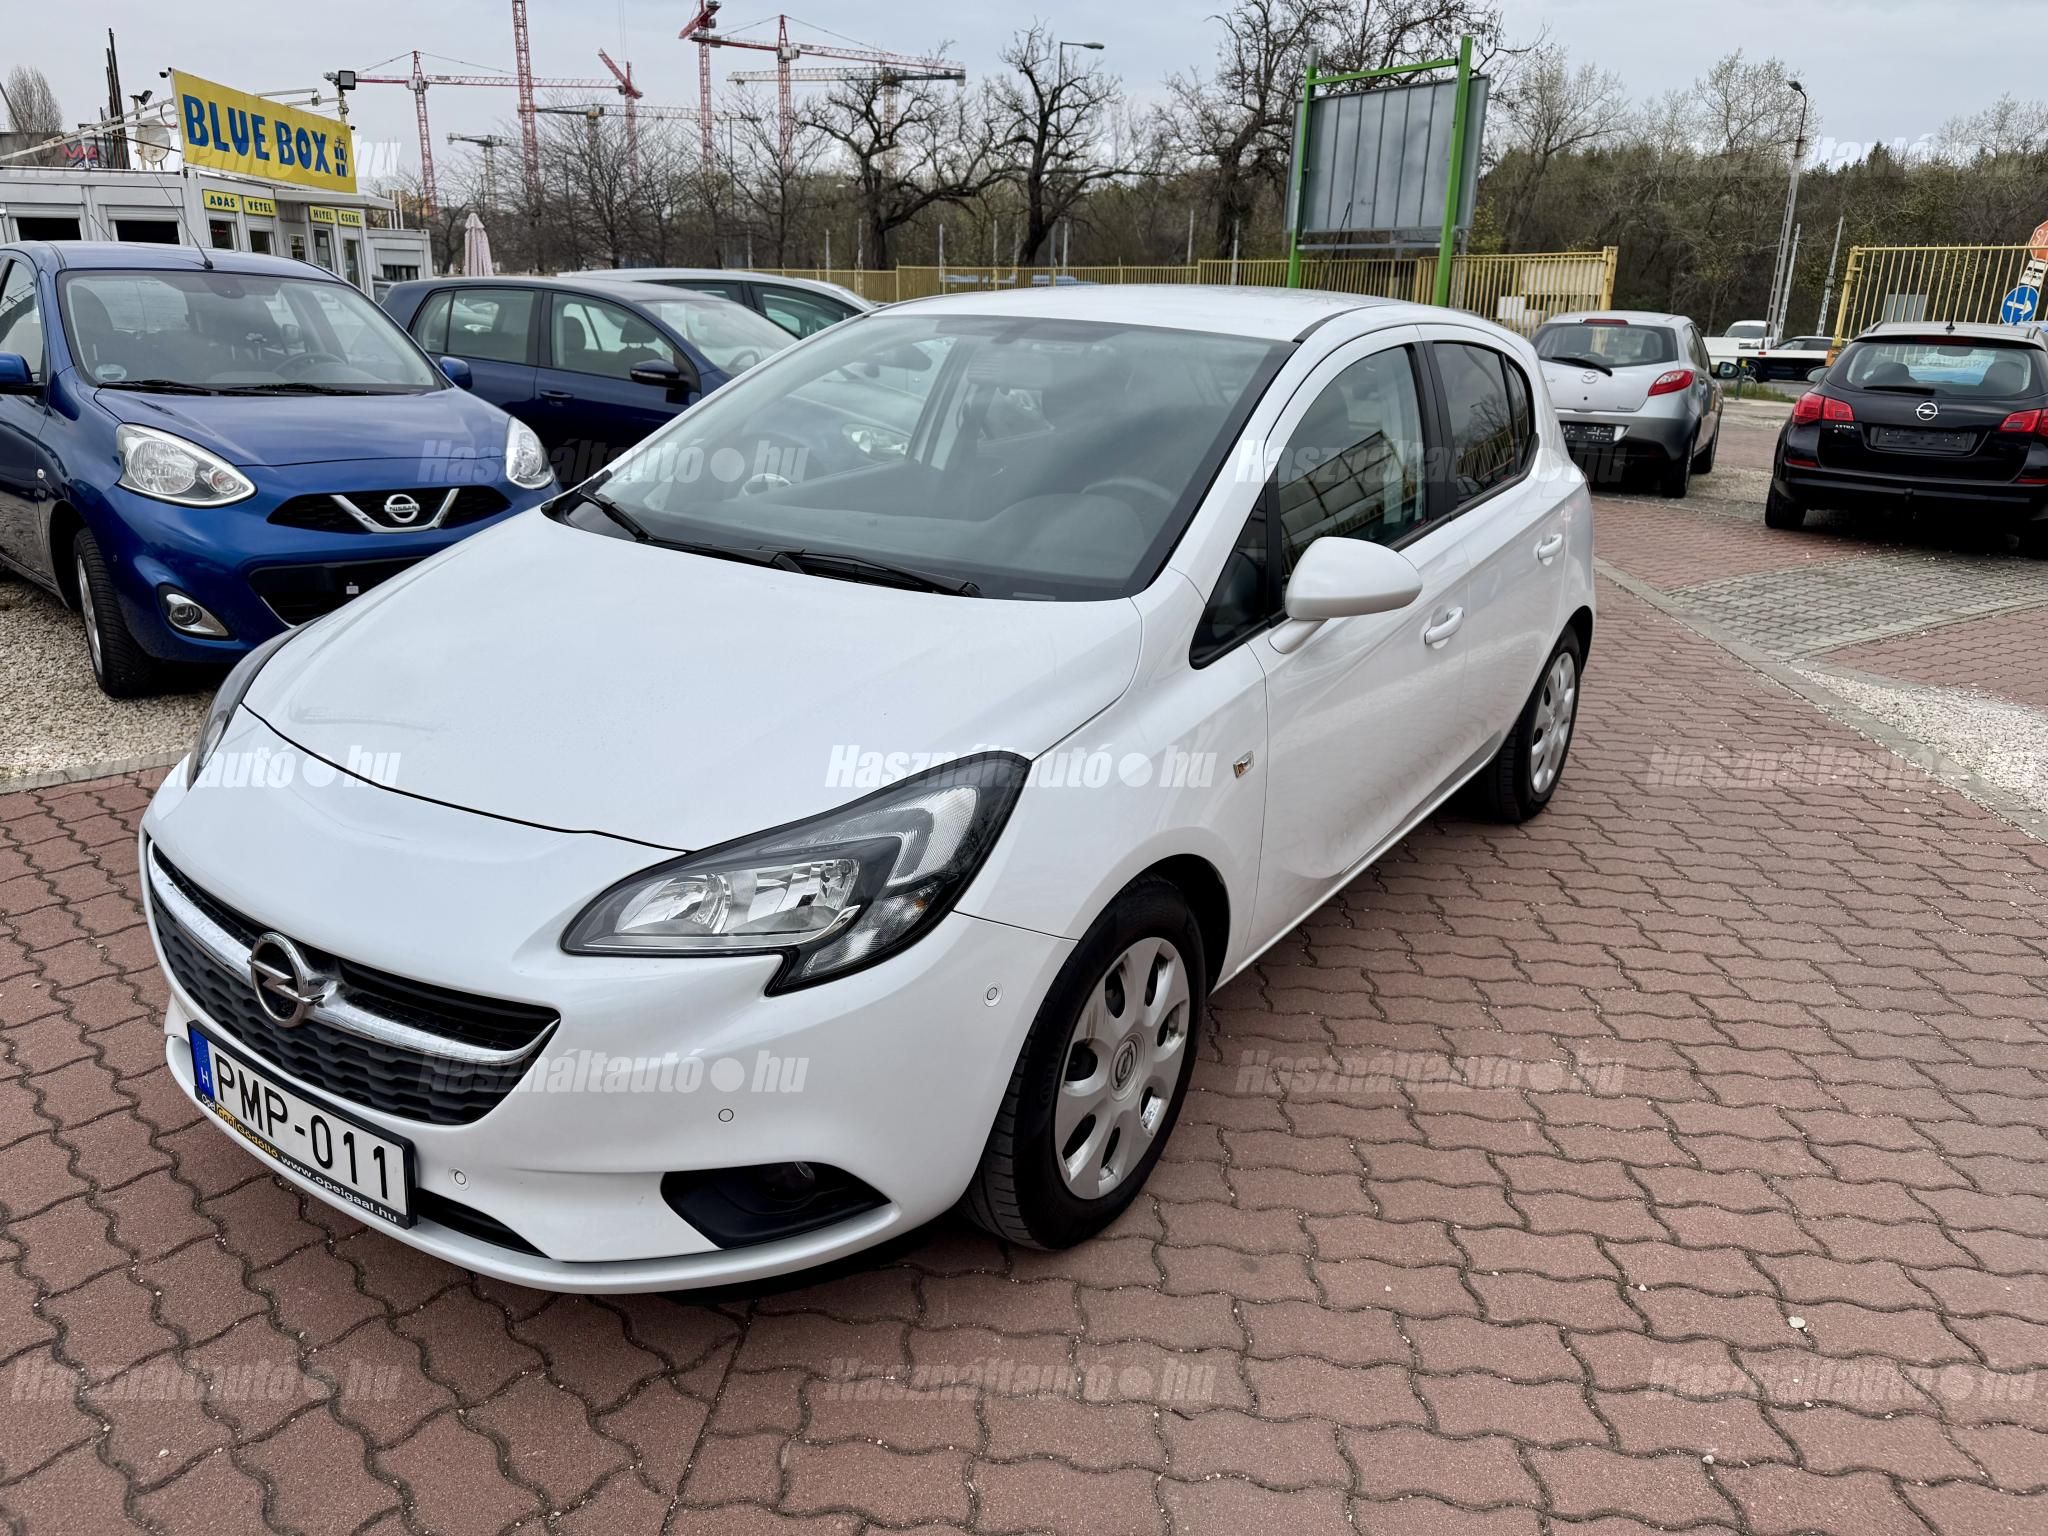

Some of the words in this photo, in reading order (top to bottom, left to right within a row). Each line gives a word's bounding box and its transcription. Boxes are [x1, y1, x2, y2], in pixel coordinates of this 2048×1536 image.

[182, 93, 270, 161] BLUE
[275, 120, 332, 175] BOX
[209, 194, 235, 208] ADÁS
[247, 199, 273, 213] VÉTEL
[313, 209, 333, 220] HITEL
[341, 213, 361, 224] CSERE
[200, 1066, 210, 1088] H
[215, 1052, 388, 1200] PMP-011
[281, 1156, 397, 1223] www.opelgaal.hu
